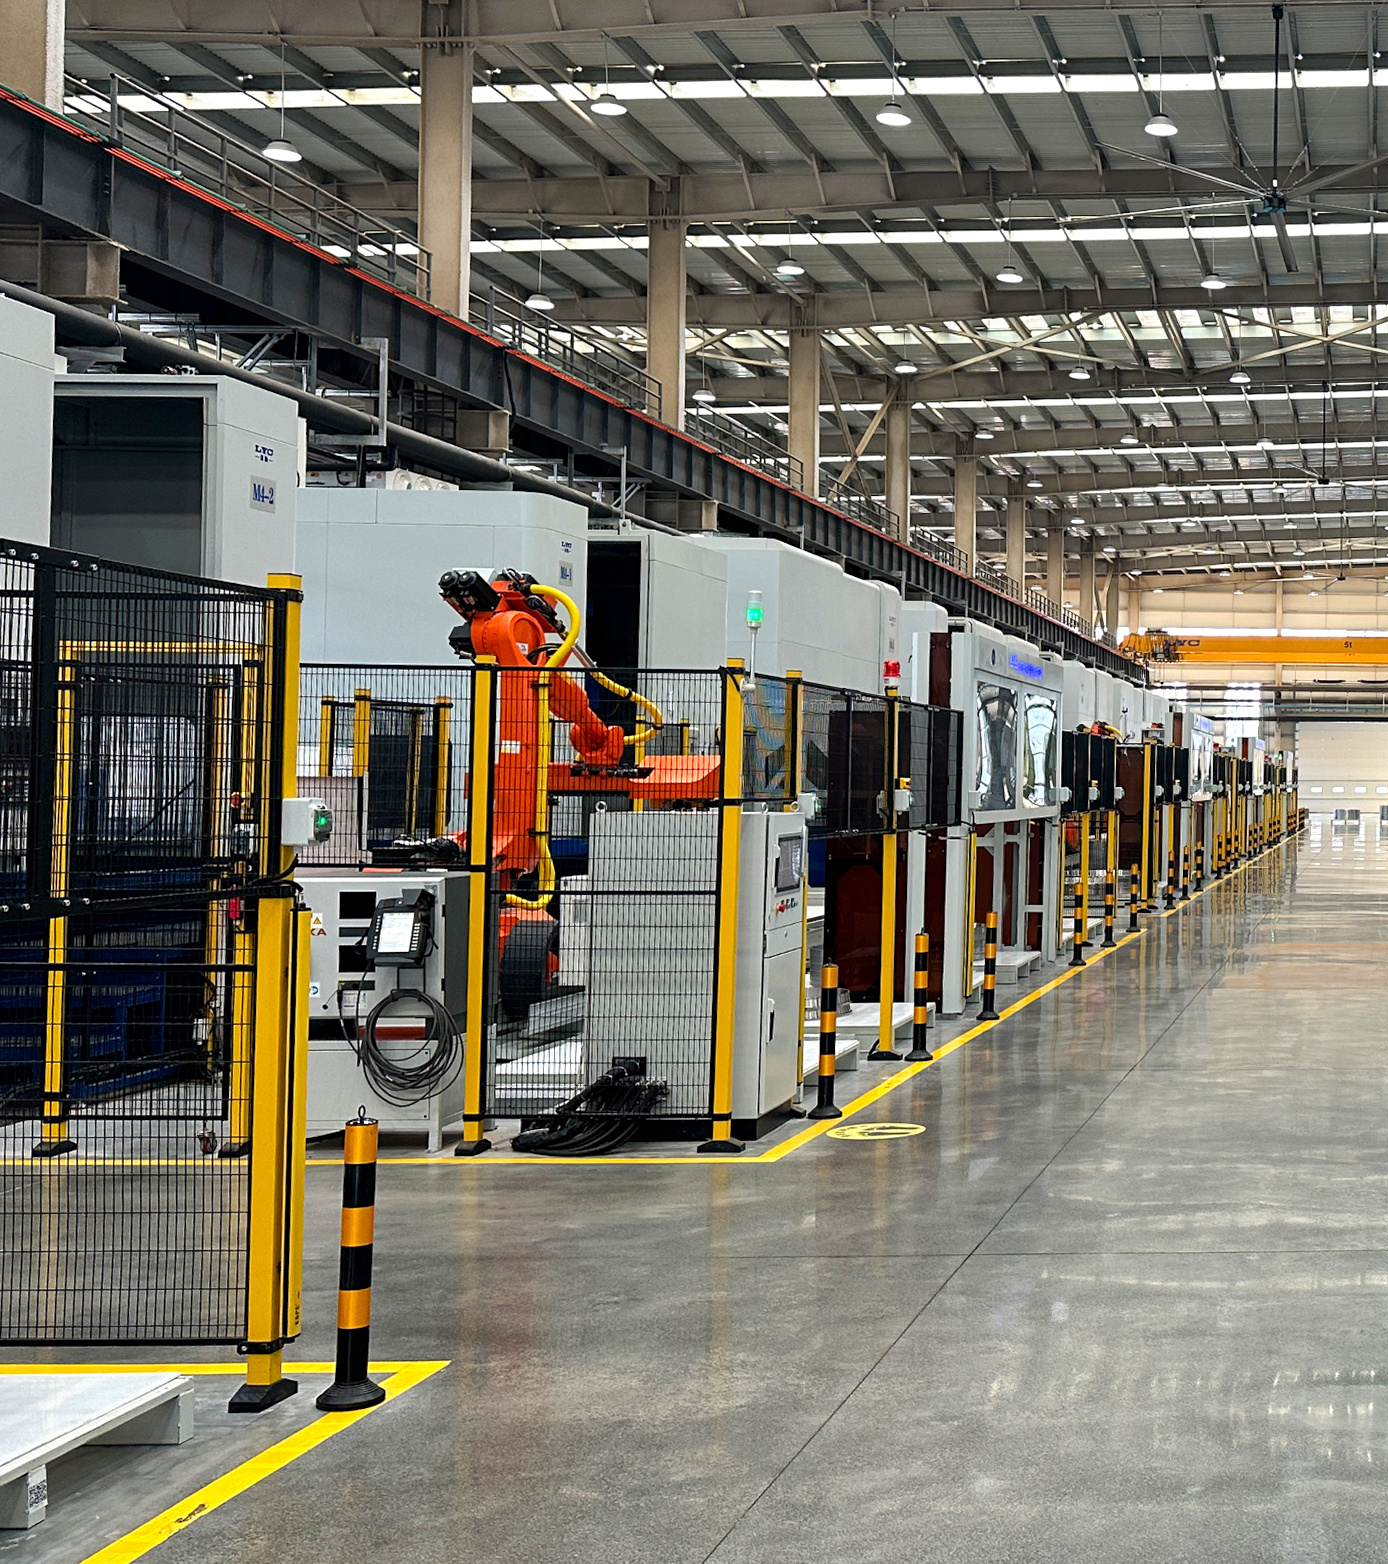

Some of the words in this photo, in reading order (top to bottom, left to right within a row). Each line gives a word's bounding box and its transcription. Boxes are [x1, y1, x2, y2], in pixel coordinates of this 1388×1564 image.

[255, 444, 274, 456] LYC
[252, 483, 274, 505] M4-2
[1344, 641, 1352, 649] 5t
